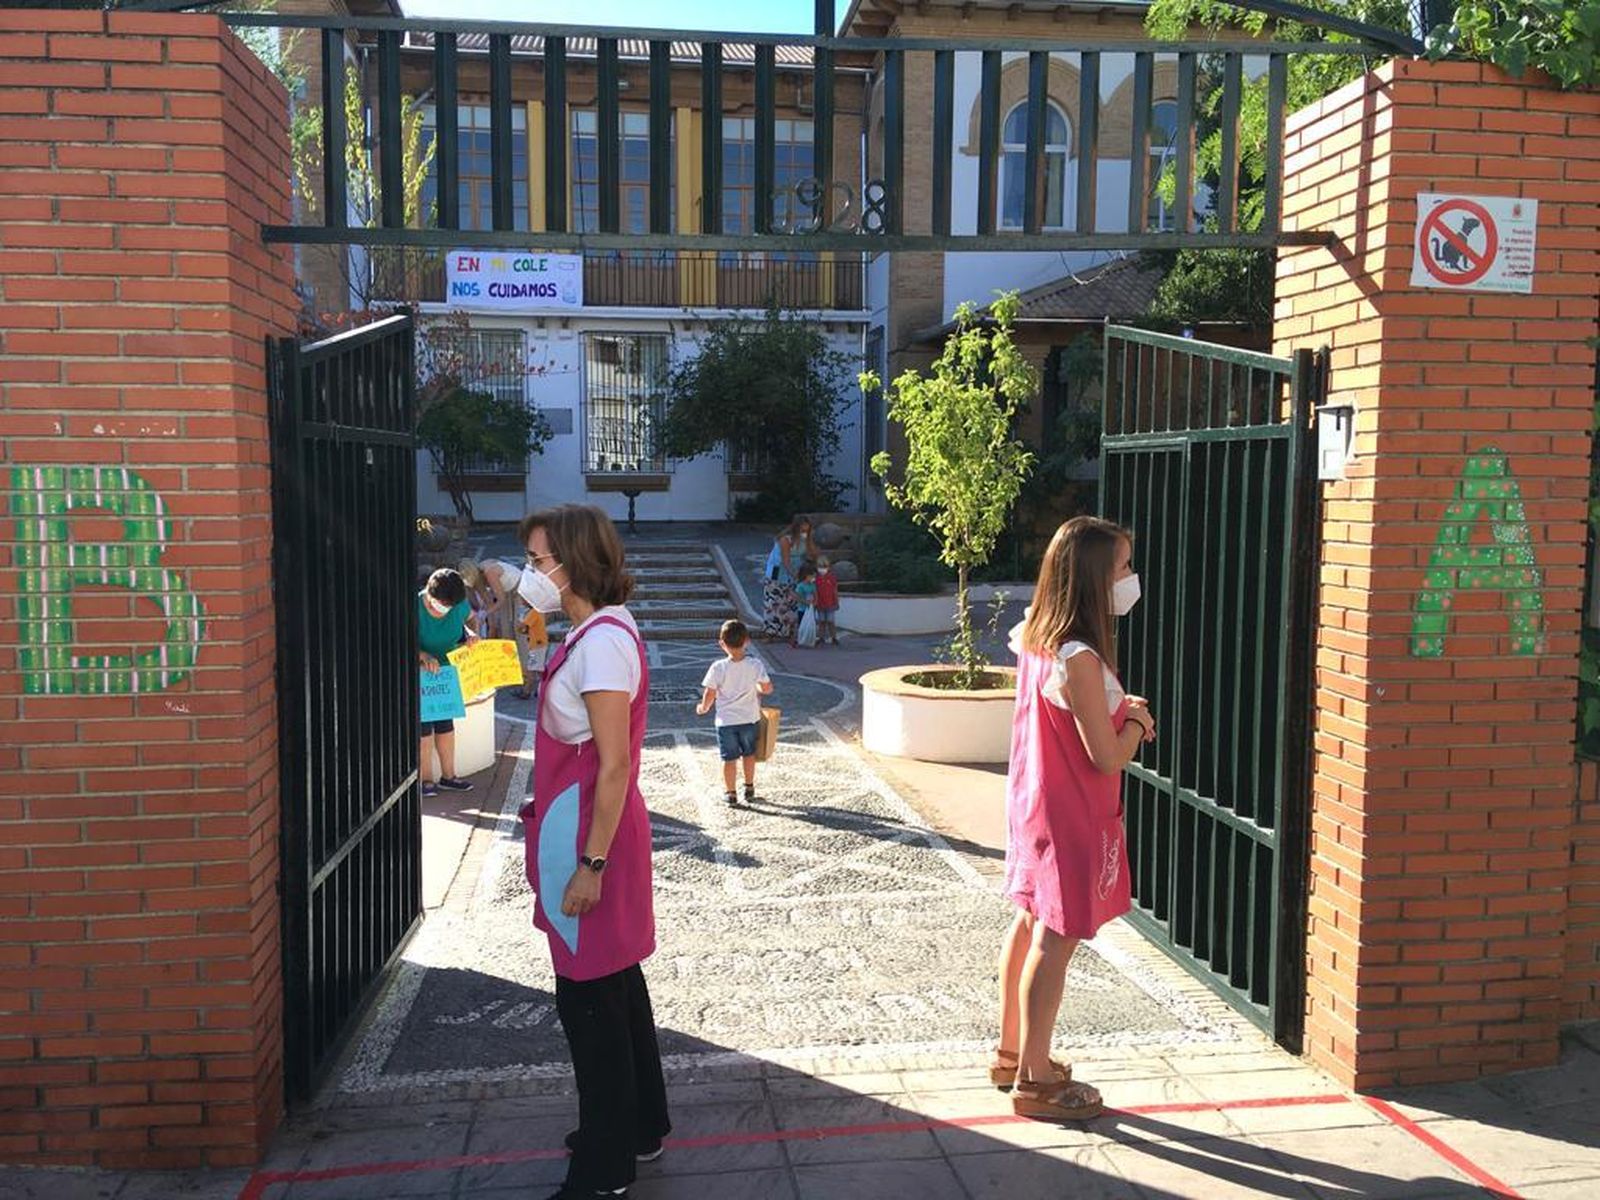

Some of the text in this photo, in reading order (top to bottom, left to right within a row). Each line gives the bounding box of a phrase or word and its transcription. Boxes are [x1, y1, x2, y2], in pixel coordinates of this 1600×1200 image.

[766, 178, 887, 236] 1928
[452, 281, 558, 298] NOS CUIDAMOS
[457, 256, 481, 272] EN
[513, 258, 549, 273] COLE
[10, 466, 206, 694] B
[1410, 446, 1546, 657] A
